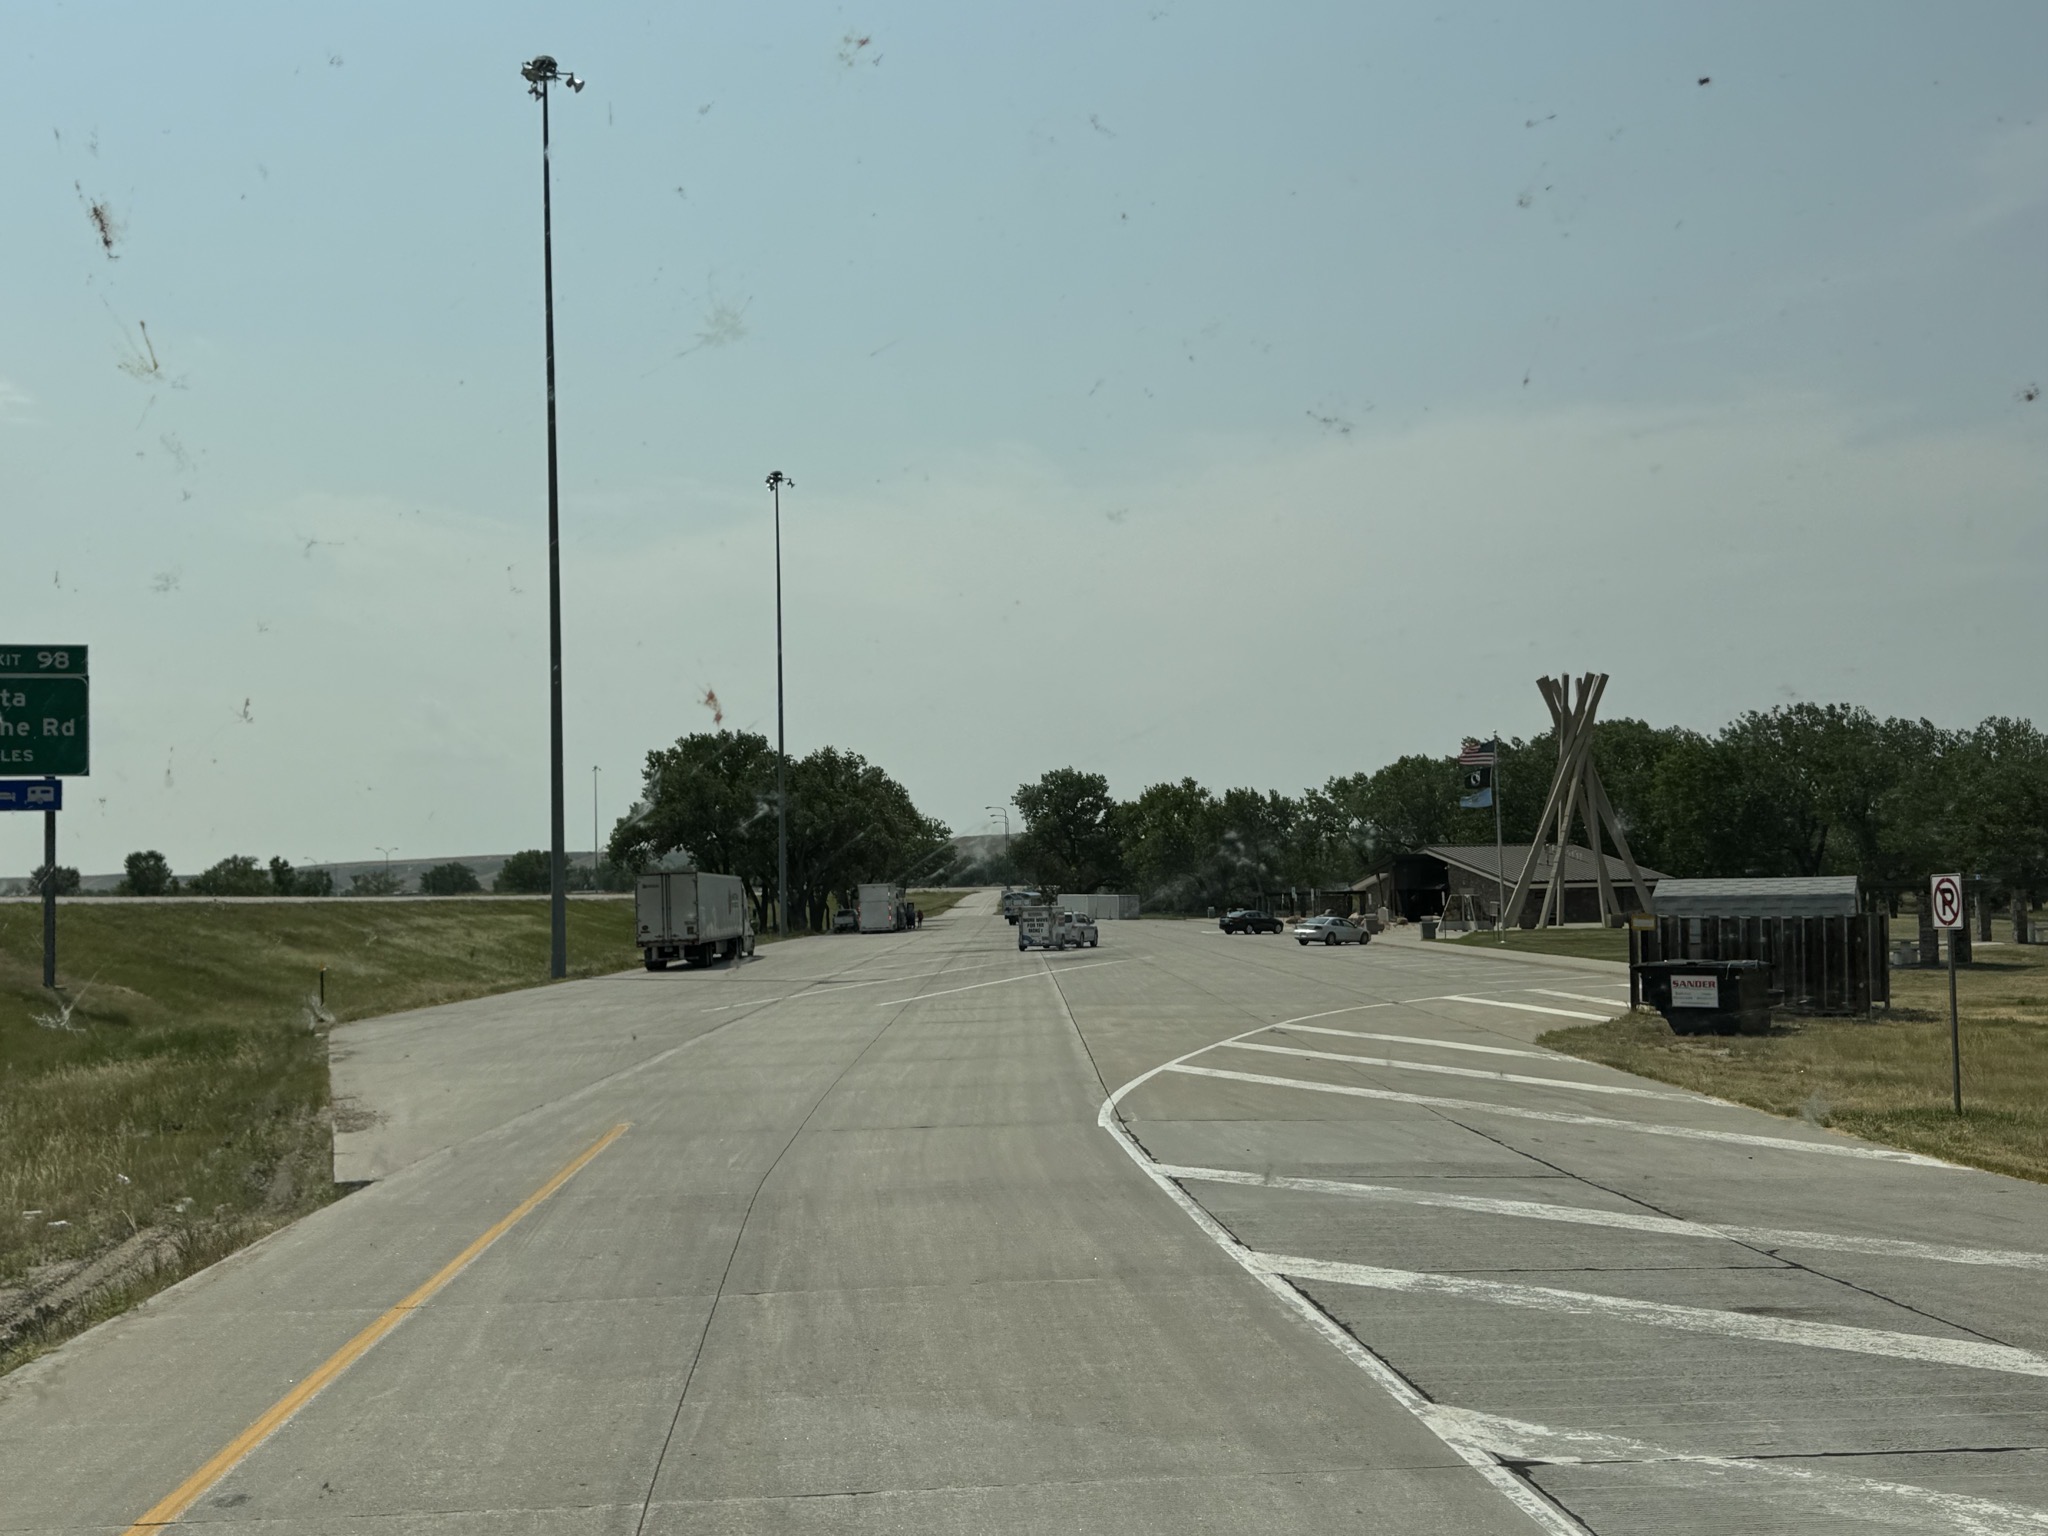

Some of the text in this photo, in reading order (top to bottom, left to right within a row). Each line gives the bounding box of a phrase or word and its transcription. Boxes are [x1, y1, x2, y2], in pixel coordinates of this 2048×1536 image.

[37, 652, 69, 669] 98
[42, 718, 75, 736] Rd
[1, 749, 34, 762] LES
[1672, 979, 1716, 989] SANDER
